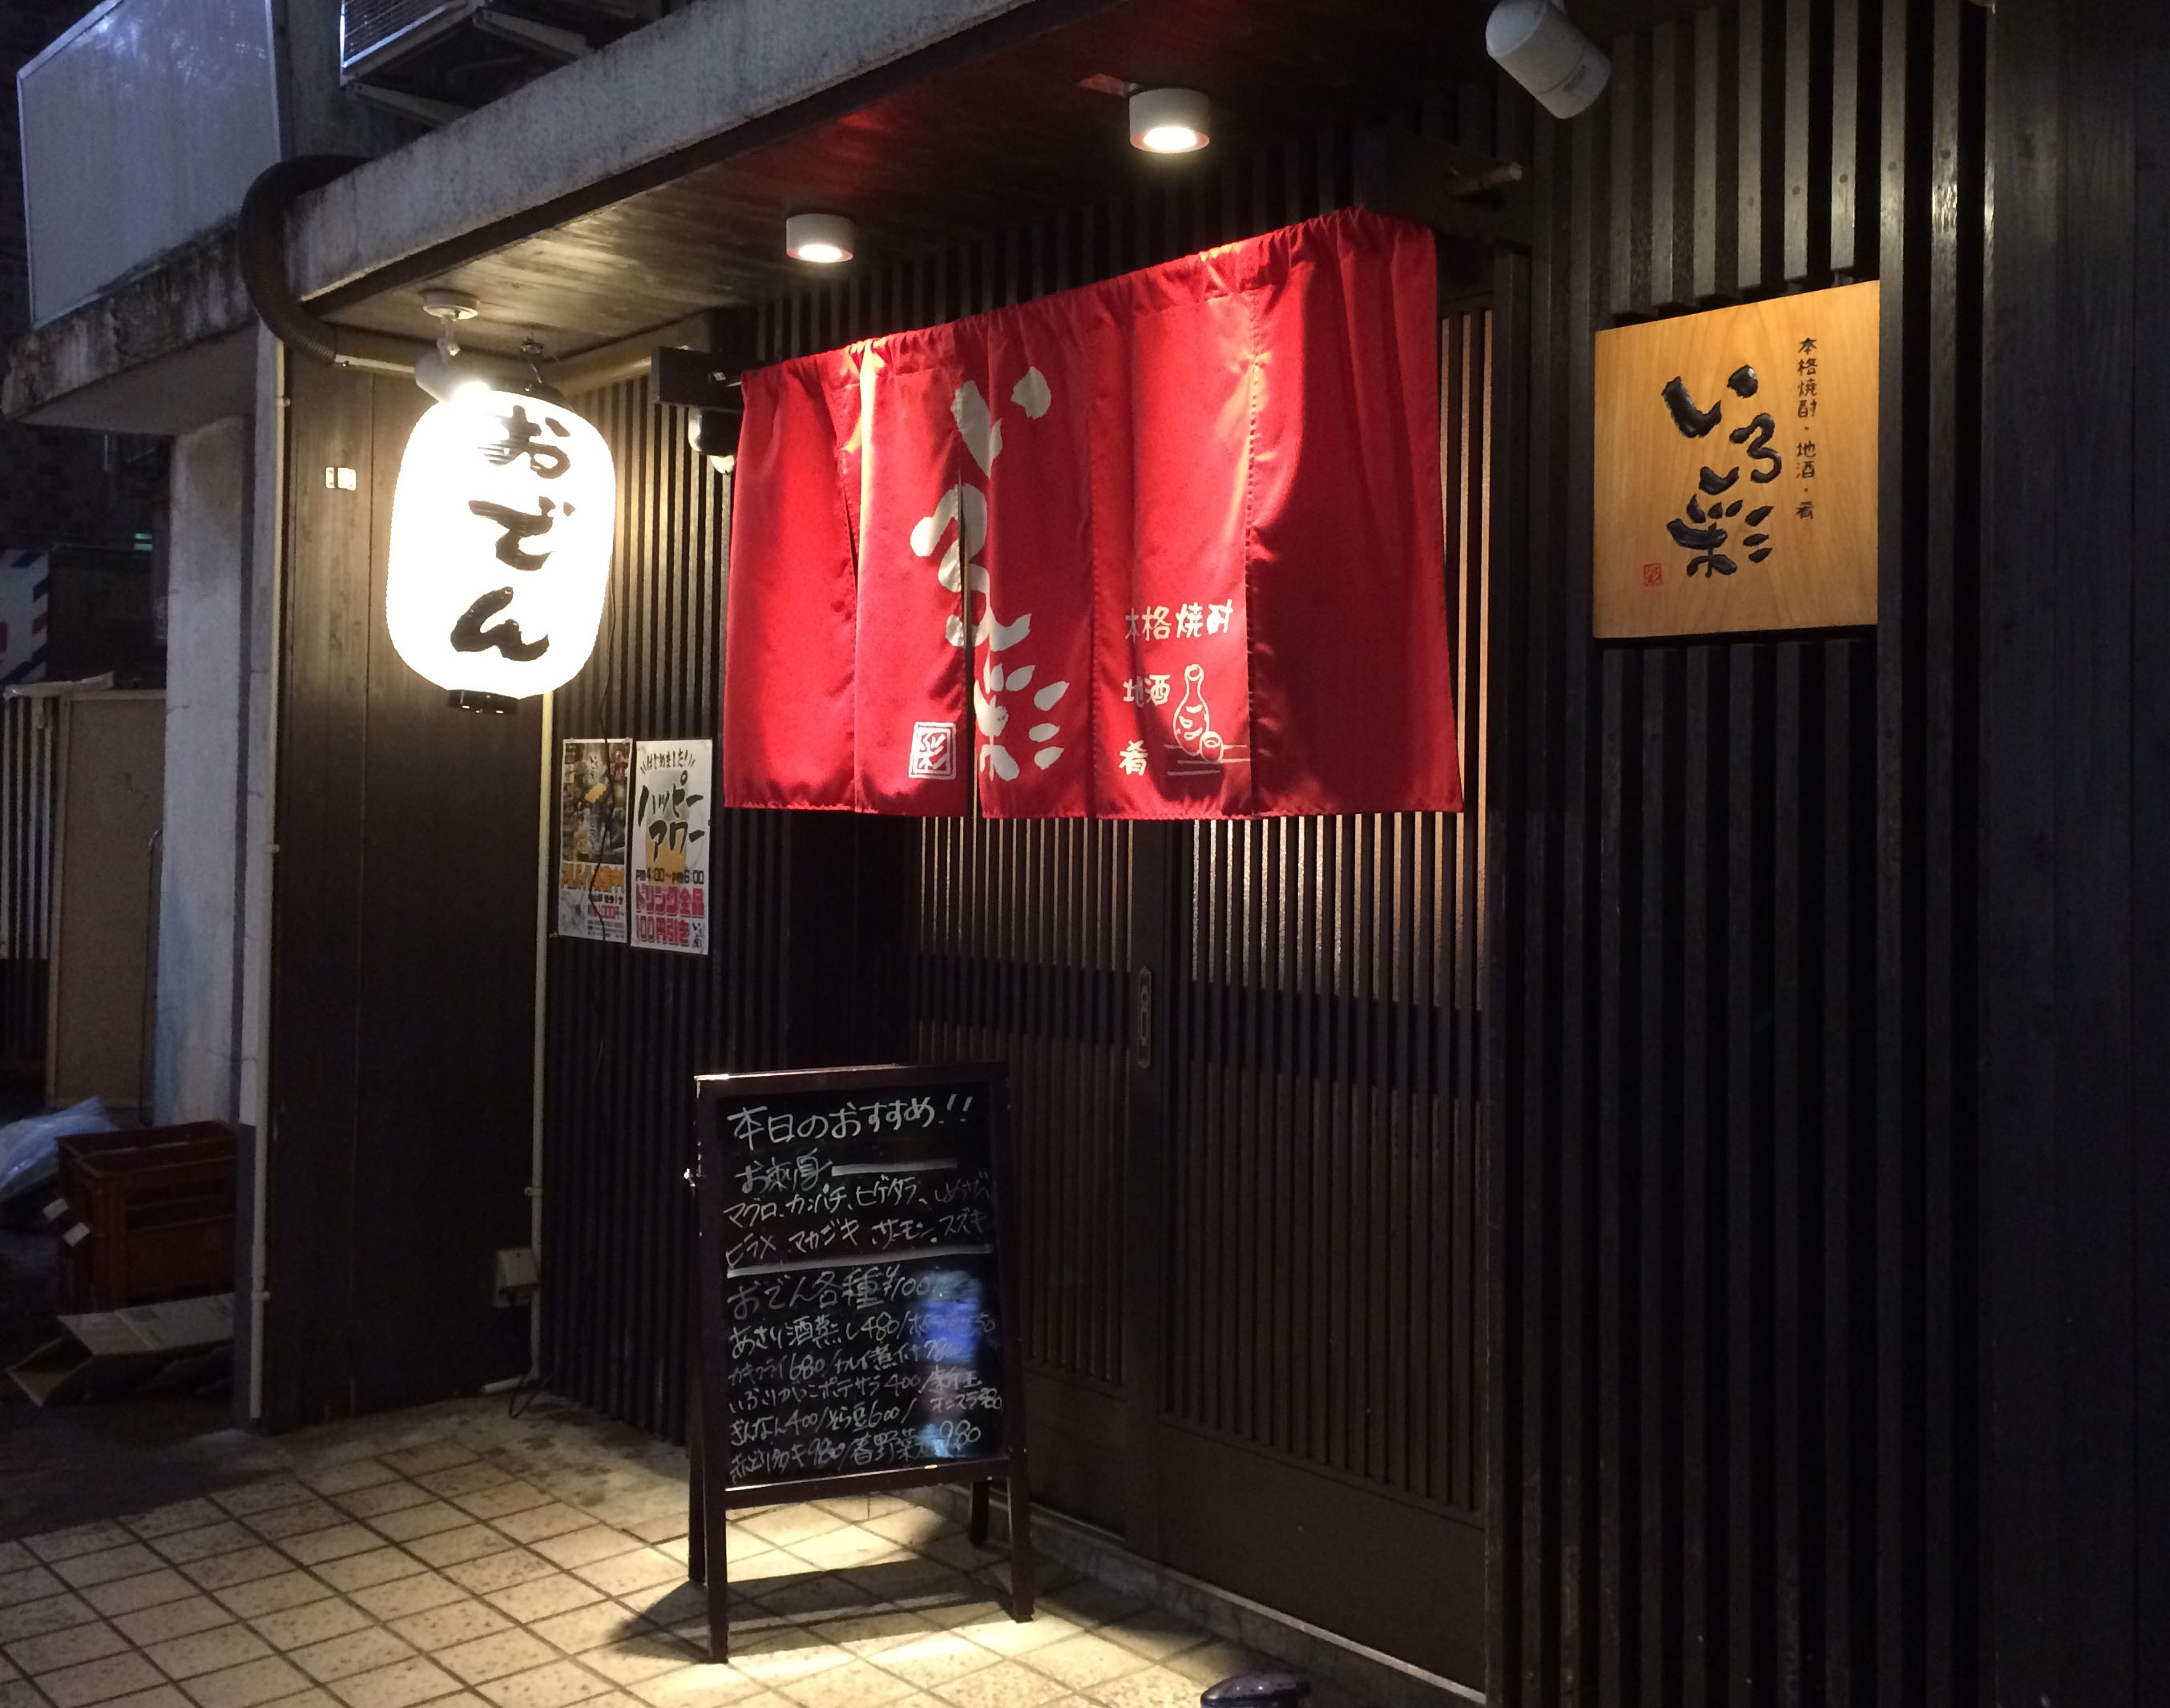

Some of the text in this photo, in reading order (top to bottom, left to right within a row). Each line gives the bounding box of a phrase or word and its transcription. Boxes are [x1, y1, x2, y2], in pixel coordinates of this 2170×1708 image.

[1660, 364, 1782, 578] いろ彩
[450, 405, 576, 662] おでん
[1124, 598, 1234, 643] 本格焼酎
[1122, 673, 1172, 708] 地酒
[1118, 739, 1149, 777] 肴
[637, 769, 705, 828] ハッピー
[648, 819, 706, 864] アワー
[635, 884, 705, 918] ドリンク全品
[635, 914, 691, 946] 100円引き
[735, 1147, 833, 1194] お刺身
